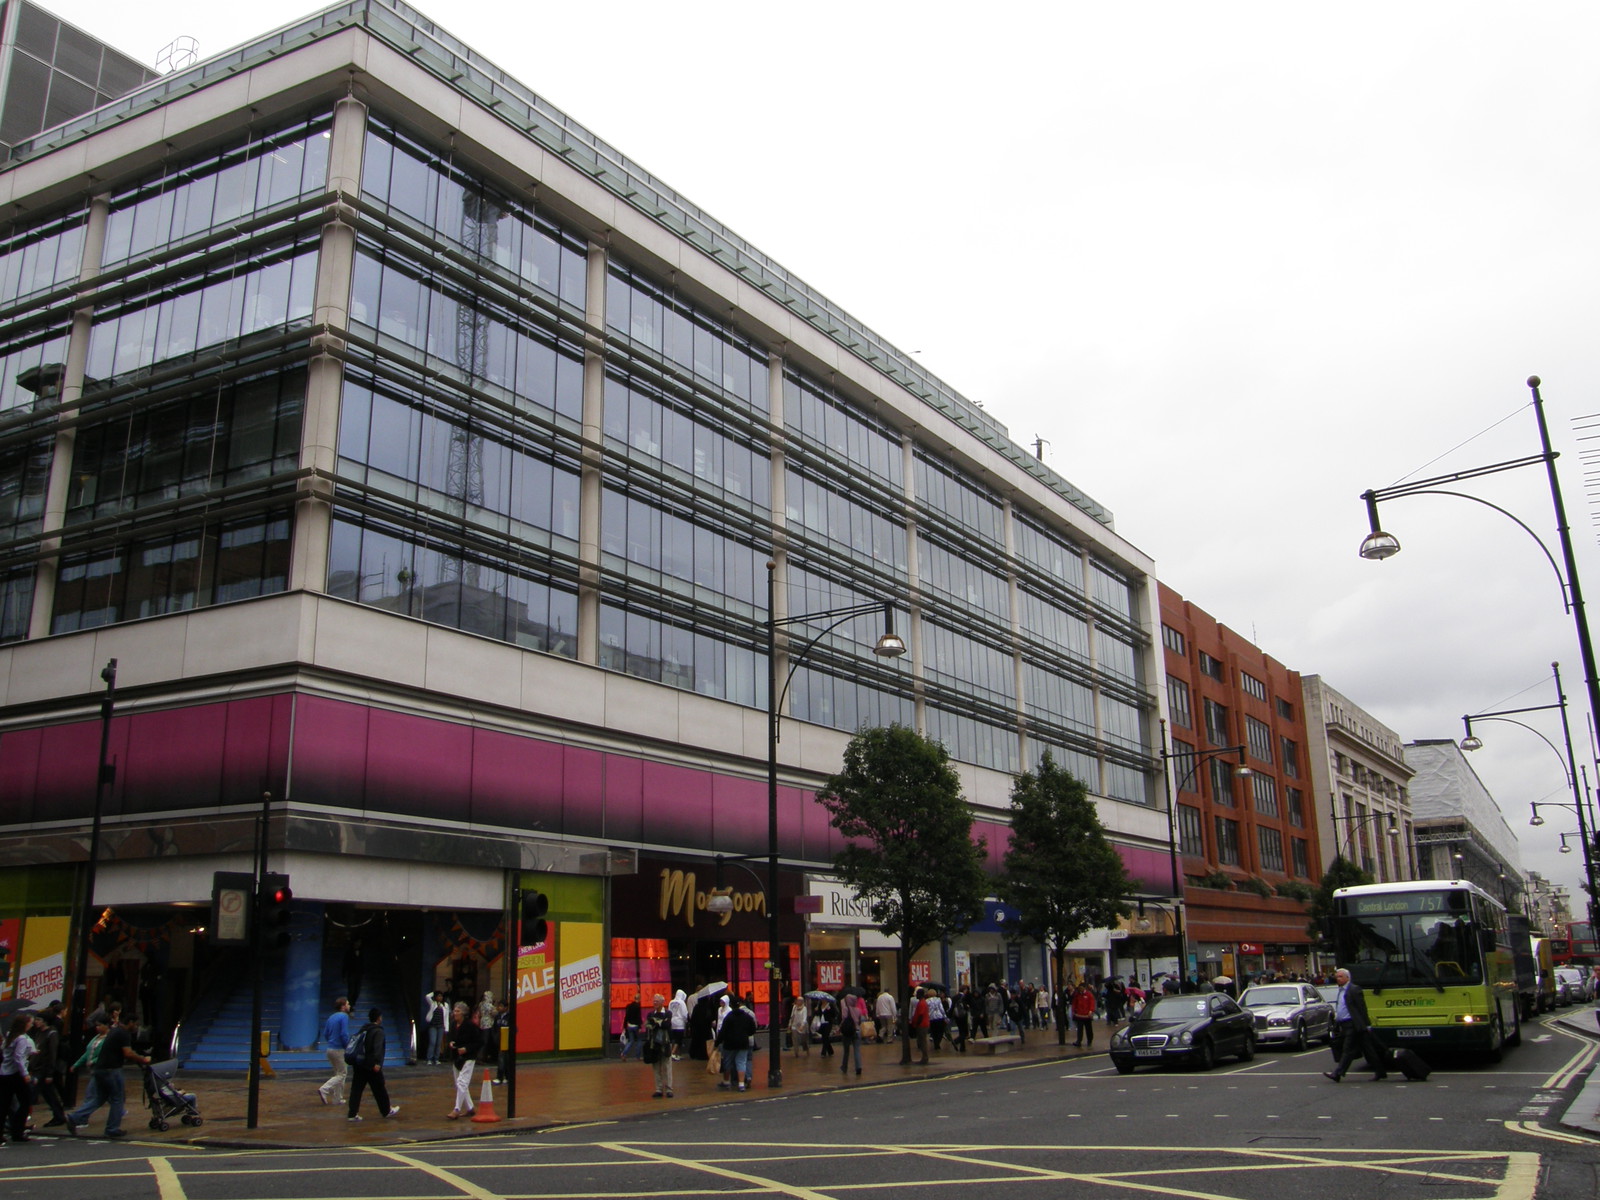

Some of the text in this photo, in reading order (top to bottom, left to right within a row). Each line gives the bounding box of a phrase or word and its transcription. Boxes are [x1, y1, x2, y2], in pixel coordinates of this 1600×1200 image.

[831, 891, 875, 918] Russell
[1360, 896, 1442, 912] Central London 757
[611, 940, 634, 953] ALE
[19, 966, 63, 992] FURTHER
[560, 966, 601, 990] FURTHER
[821, 966, 841, 984] SALE
[911, 965, 929, 982] SALE
[20, 980, 64, 1000] REDUCTIONS
[562, 979, 602, 1000] REDUCTIONS
